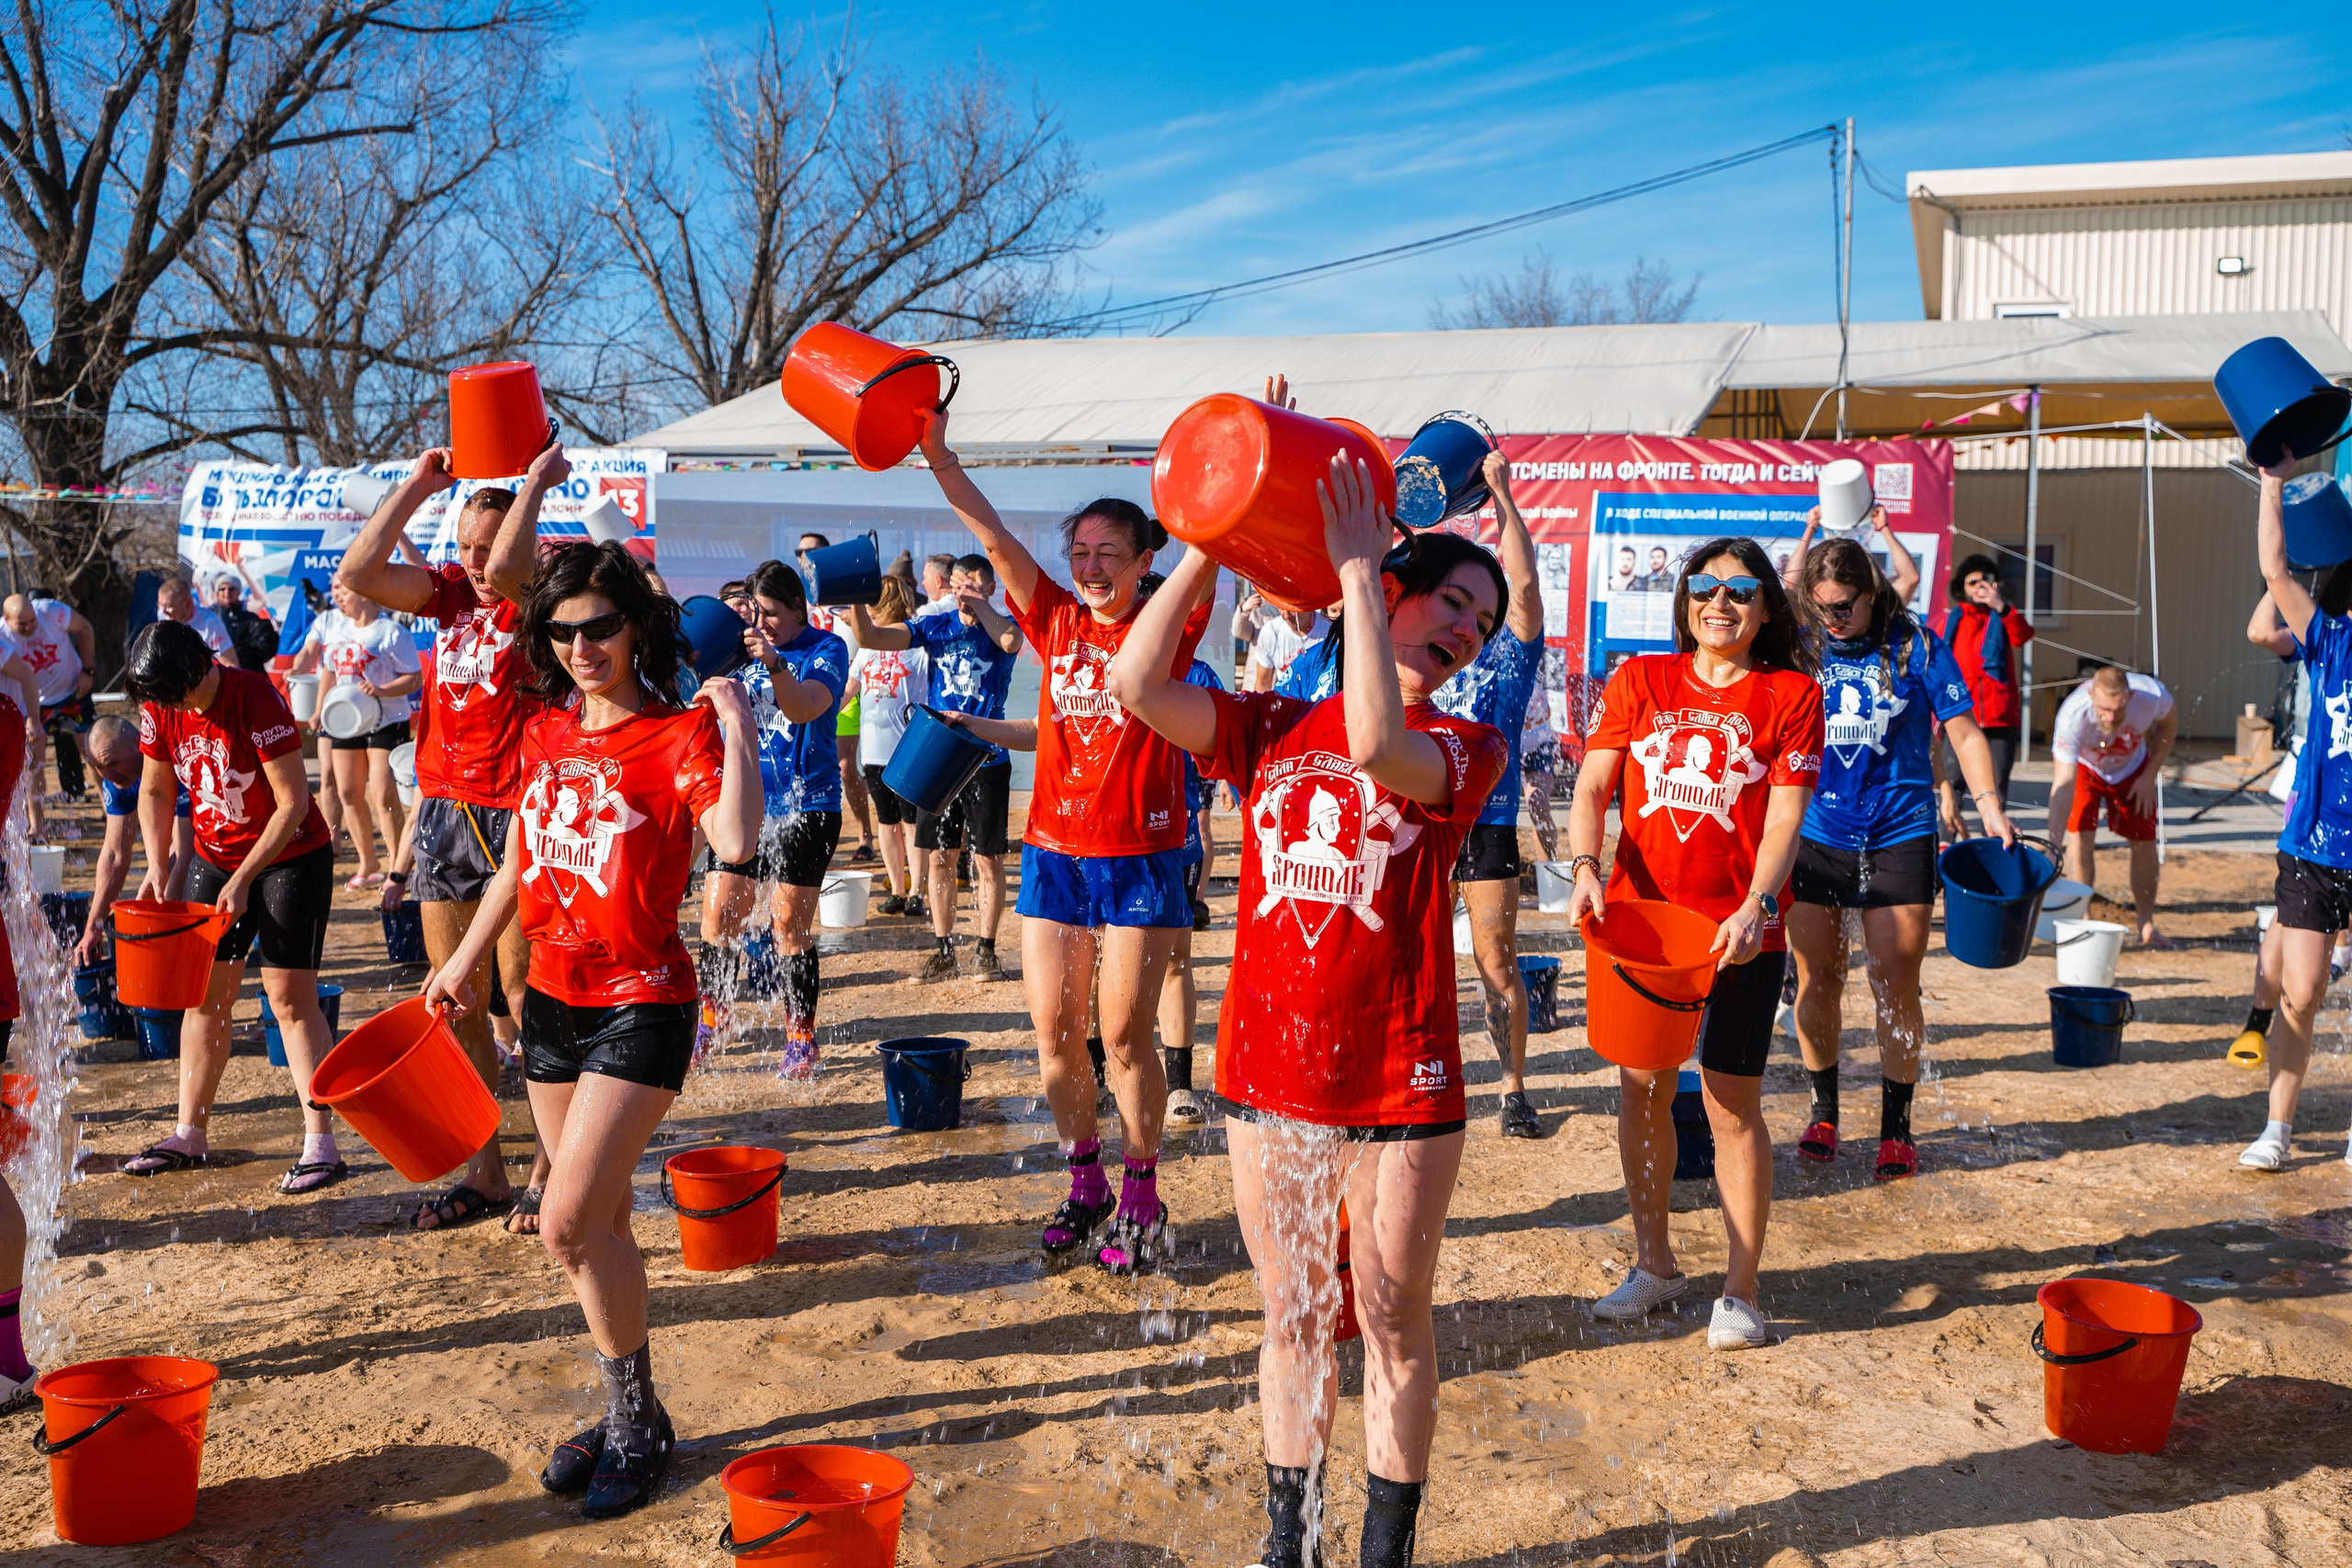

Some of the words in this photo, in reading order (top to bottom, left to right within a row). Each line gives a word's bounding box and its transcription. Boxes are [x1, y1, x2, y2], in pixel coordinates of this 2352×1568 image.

[591, 460, 647, 473] АКЦИЯ
[1510, 462, 1586, 479] ТСМЕНЫ
[1589, 462, 1614, 479] НА
[1617, 460, 1695, 481] ФРОНТЕ.
[1700, 462, 1757, 484] ТОГДА
[1759, 463, 1773, 481] И
[1777, 460, 1821, 482] СЕЙ
[1605, 507, 1614, 519] В
[1615, 507, 1643, 520] ХОДЕ
[1643, 507, 1718, 521] СПЕЦИАЛЬНОЙ
[1718, 507, 1768, 522] ВОЕННОЙ
[304, 554, 342, 570] МАС
[263, 725, 285, 738] ПУТЬ
[265, 726, 295, 745] ДОМОЙ
[1827, 722, 1876, 739] РОПОЛК
[1653, 775, 1727, 808] ЯРОПОЛК
[1148, 819, 1170, 828] SPORT
[1272, 854, 1366, 896] ЯРОПОЛК
[1414, 1060, 1443, 1076] N1
[1409, 1076, 1448, 1086] SPORT
